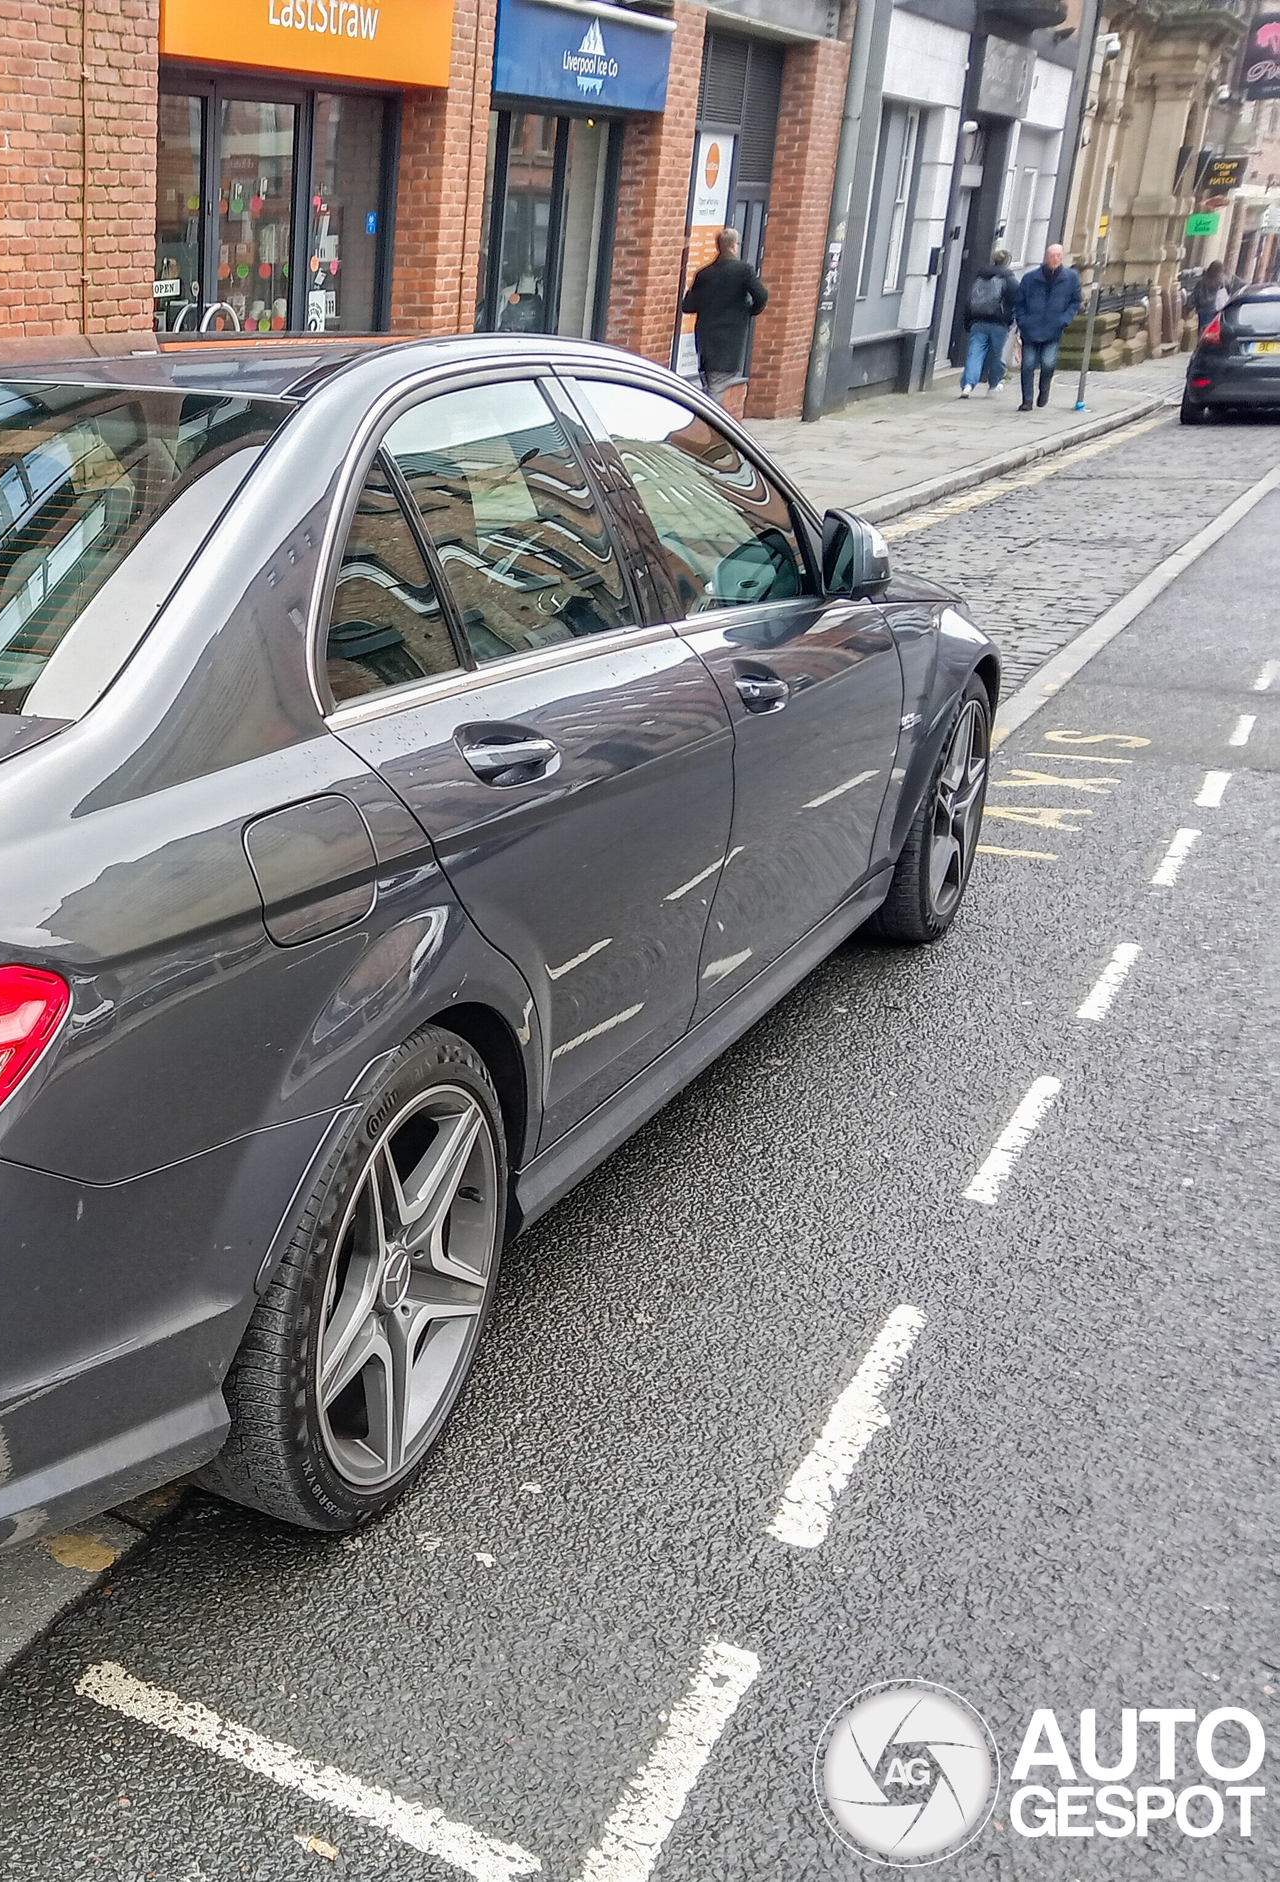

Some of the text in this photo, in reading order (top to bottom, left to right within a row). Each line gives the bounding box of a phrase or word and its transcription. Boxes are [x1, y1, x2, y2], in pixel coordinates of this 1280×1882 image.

[268, 0, 379, 41] LastStraw
[562, 50, 618, 77] Liverpool Ice Co
[1214, 162, 1238, 171] DOWN
[1209, 177, 1237, 185] HATCH
[154, 283, 175, 294] OPEN
